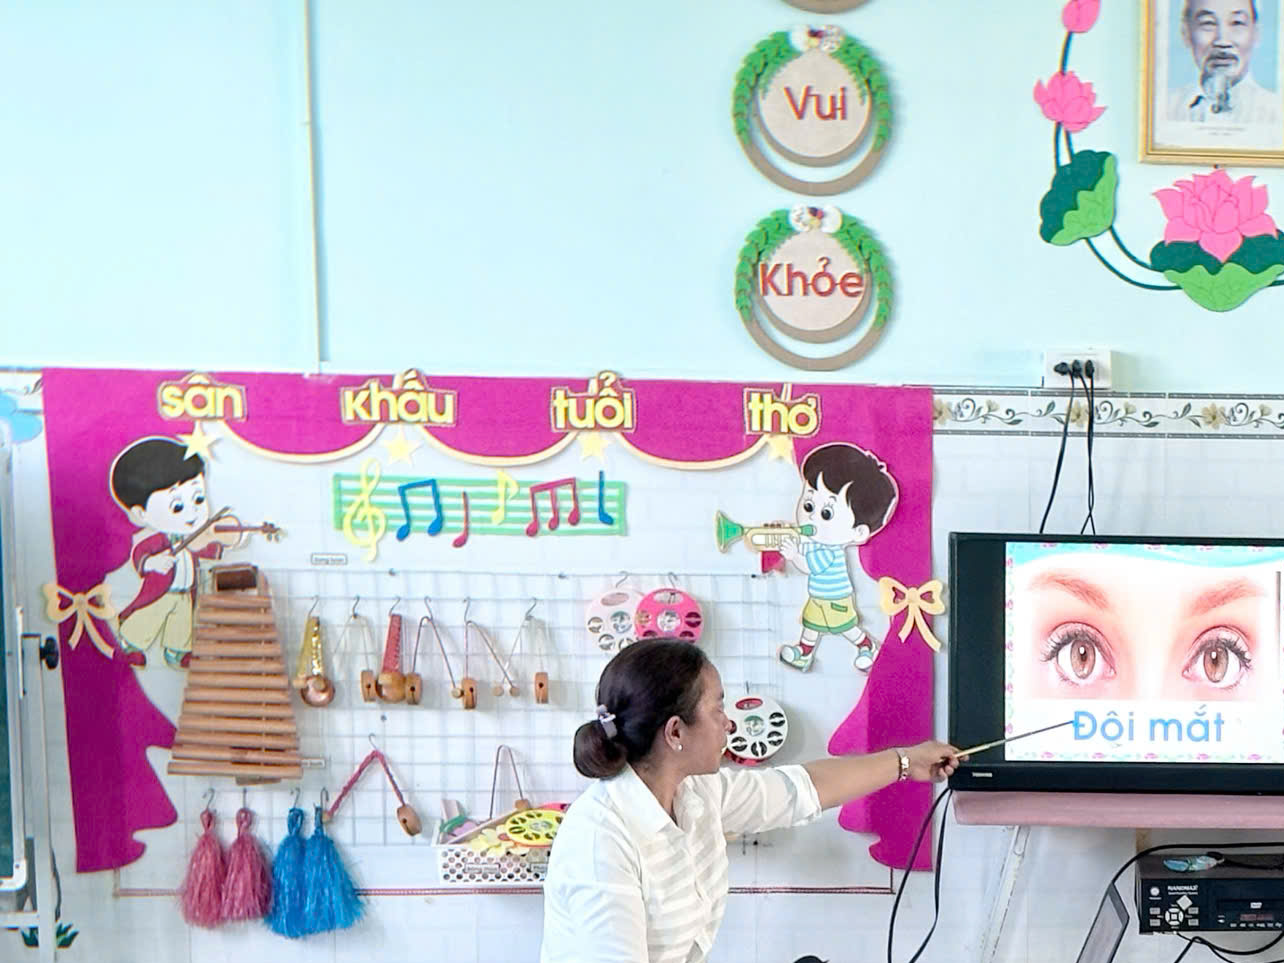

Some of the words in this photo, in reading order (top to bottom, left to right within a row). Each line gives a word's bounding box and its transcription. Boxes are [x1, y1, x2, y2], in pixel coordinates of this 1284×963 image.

[784, 86, 847, 121] Vui
[759, 256, 864, 297] Khỏe
[161, 373, 243, 418] sân
[343, 369, 454, 422] khấu
[553, 372, 633, 428] tuổi
[749, 392, 817, 435] thơ
[1072, 710, 1135, 741] Đôi
[1149, 704, 1225, 743] mắt
